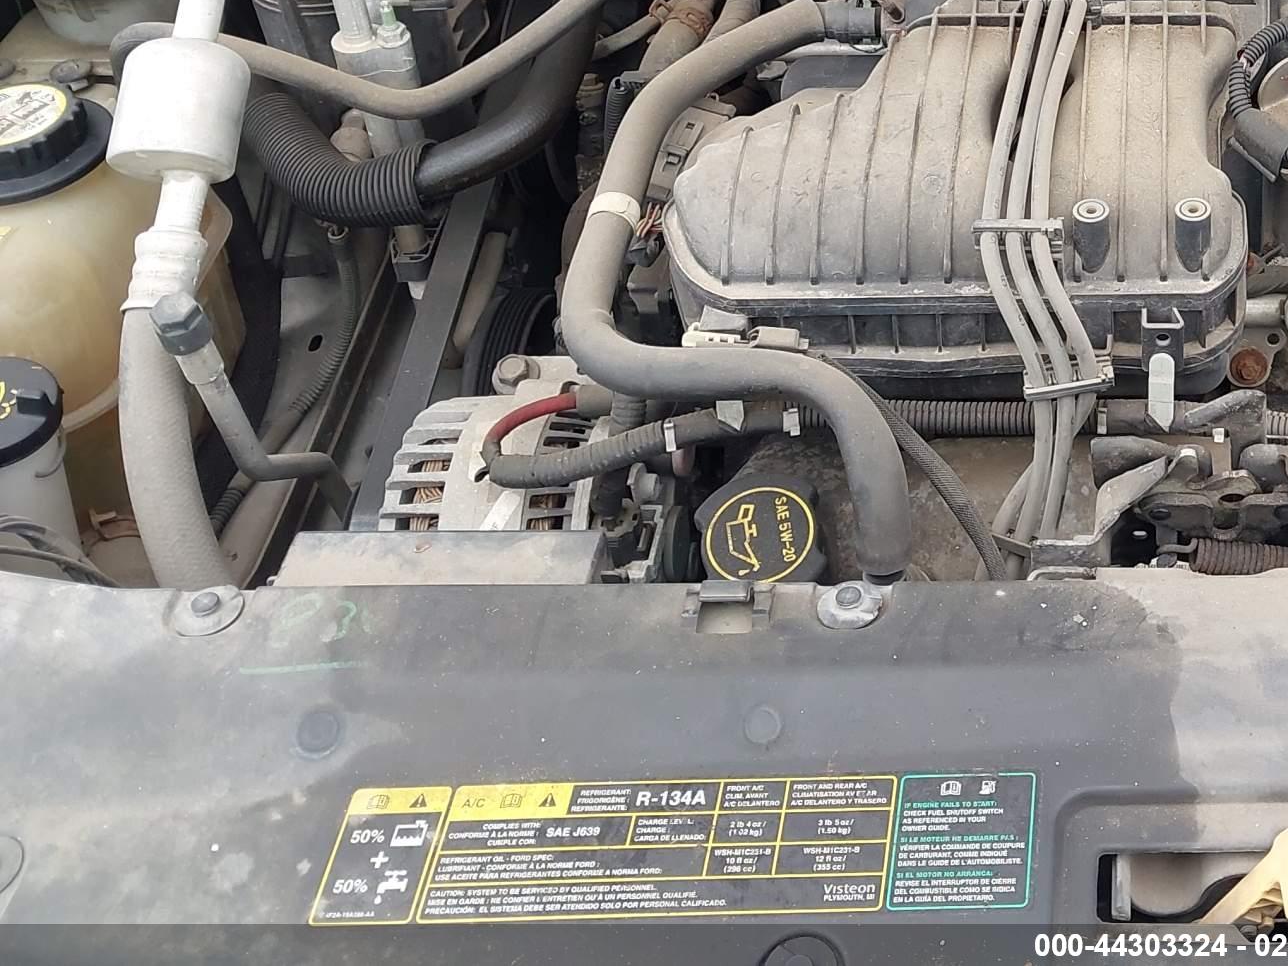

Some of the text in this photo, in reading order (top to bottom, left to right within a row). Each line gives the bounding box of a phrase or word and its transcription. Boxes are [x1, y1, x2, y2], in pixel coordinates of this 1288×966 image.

[775, 496, 796, 562] SAE 5W-20
[462, 798, 485, 808] A/C
[636, 790, 706, 806] R-134A
[483, 822, 519, 830] COMPLIES
[839, 827, 851, 835] kg)
[350, 829, 385, 844] 50%
[546, 826, 600, 837] SAE J639
[440, 856, 492, 864] REFRIGERANT
[486, 863, 527, 871] CONFORME
[547, 861, 573, 869] NORME
[500, 870, 560, 879] REFRIGERANTES
[563, 869, 604, 877] CONFORME
[332, 878, 368, 894] 50%
[931, 878, 979, 886] INTERRUPTOR
[467, 888, 497, 896] SYSTEM
[824, 884, 875, 894] Visteon
[490, 905, 522, 913] SISTEMA
[561, 903, 599, 911] ATENDIDO
[640, 900, 679, 908] PERSONAL
